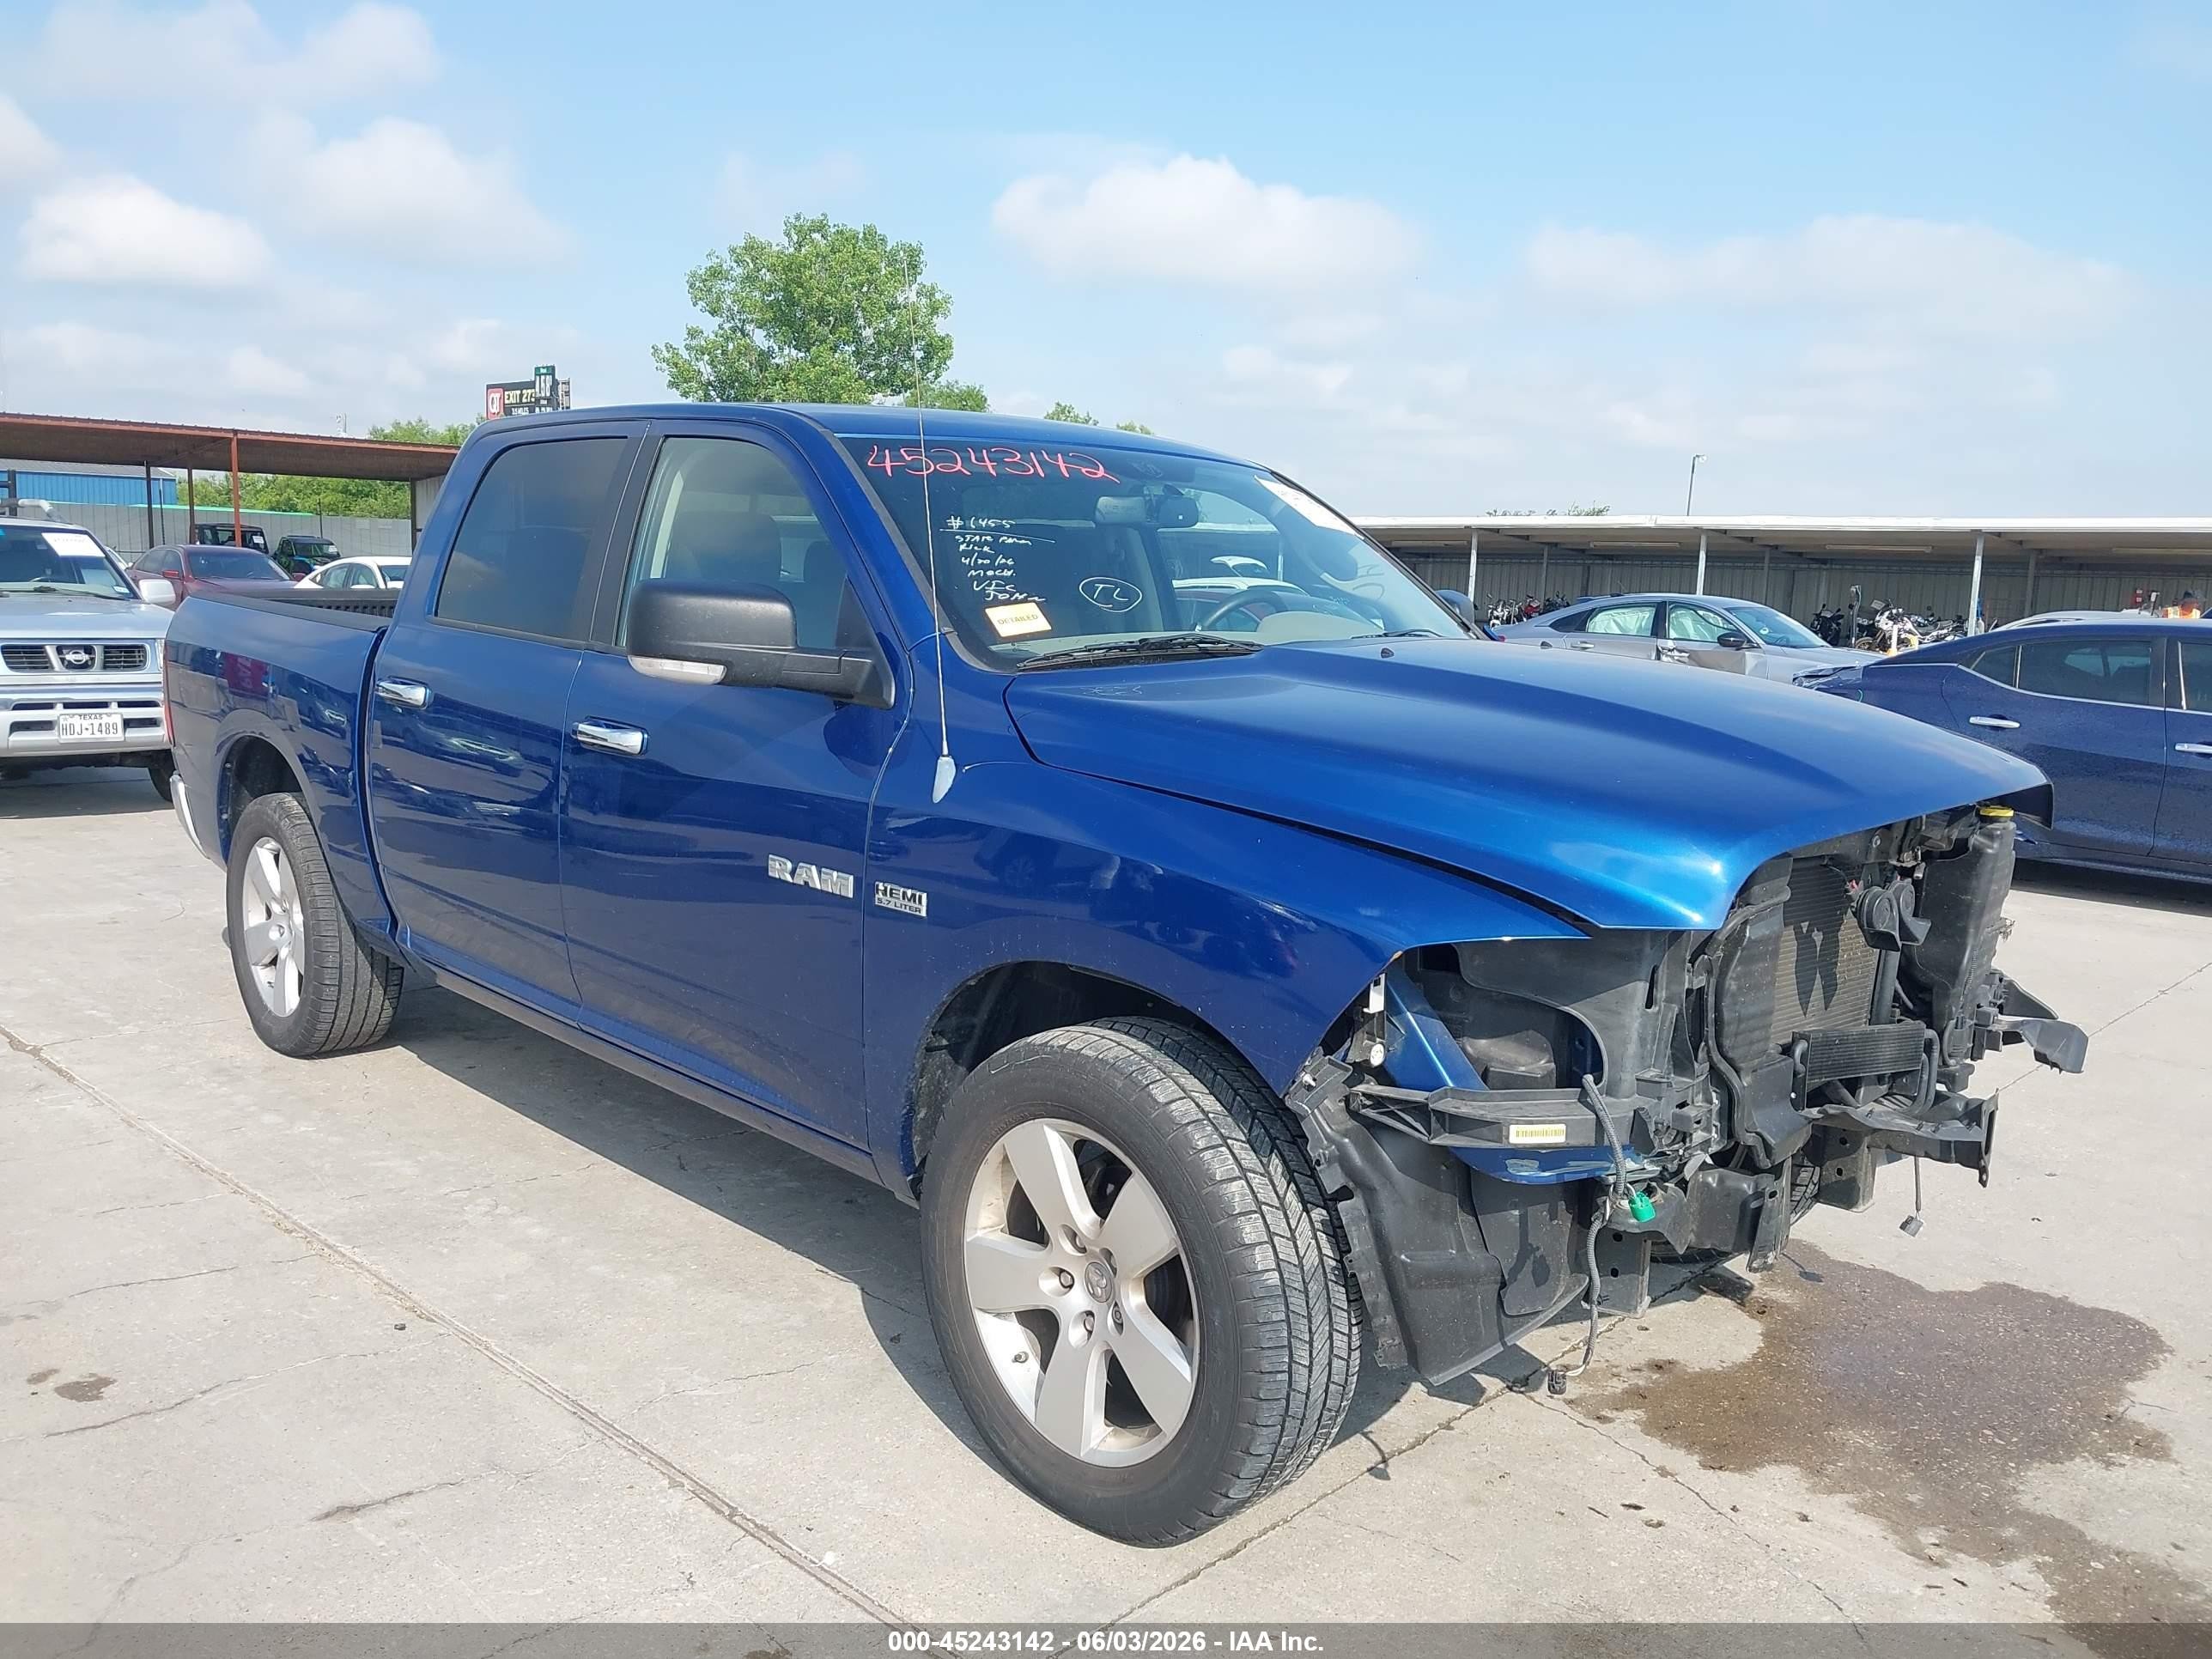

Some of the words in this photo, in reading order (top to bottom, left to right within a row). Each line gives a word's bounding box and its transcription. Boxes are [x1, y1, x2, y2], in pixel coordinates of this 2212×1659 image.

[504, 390, 521, 404] EXIT
[867, 445, 1120, 483] 45243142
[997, 614, 1038, 625] DETAILED
[768, 854, 854, 899] RAM
[876, 882, 924, 906] HEMI
[877, 897, 891, 906] 5.7
[894, 901, 921, 915] LITER
